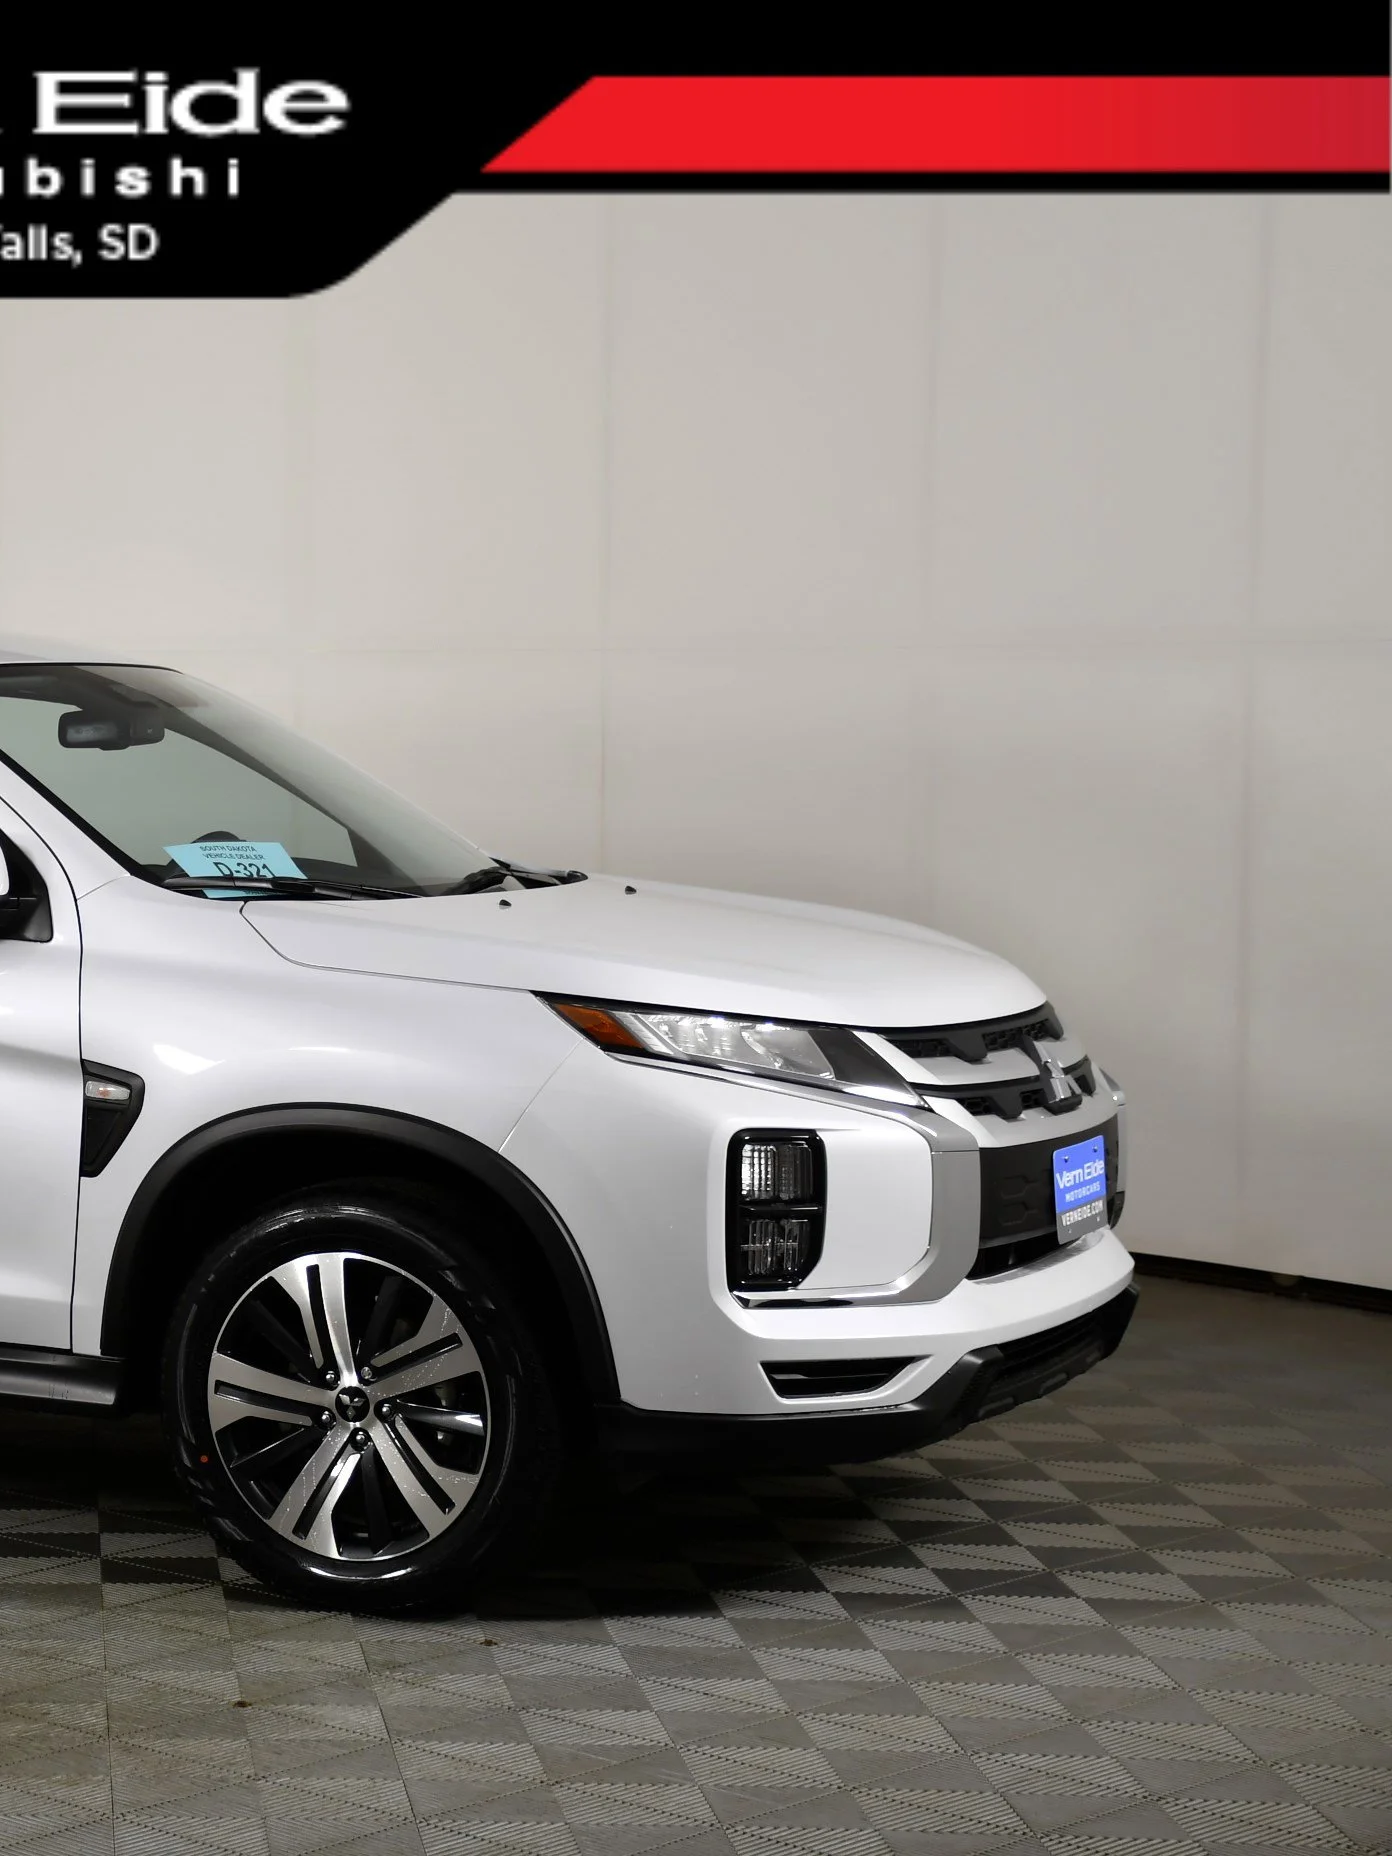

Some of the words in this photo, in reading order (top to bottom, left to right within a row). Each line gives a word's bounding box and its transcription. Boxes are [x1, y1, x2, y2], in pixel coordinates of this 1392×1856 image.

[213, 861, 277, 879] D-321
[1056, 1169, 1083, 1189] Vern
[1084, 1160, 1104, 1180] Eide
[1065, 1181, 1100, 1202] MOTORCARS
[1062, 1200, 1103, 1226] VERNEIDE.COM
